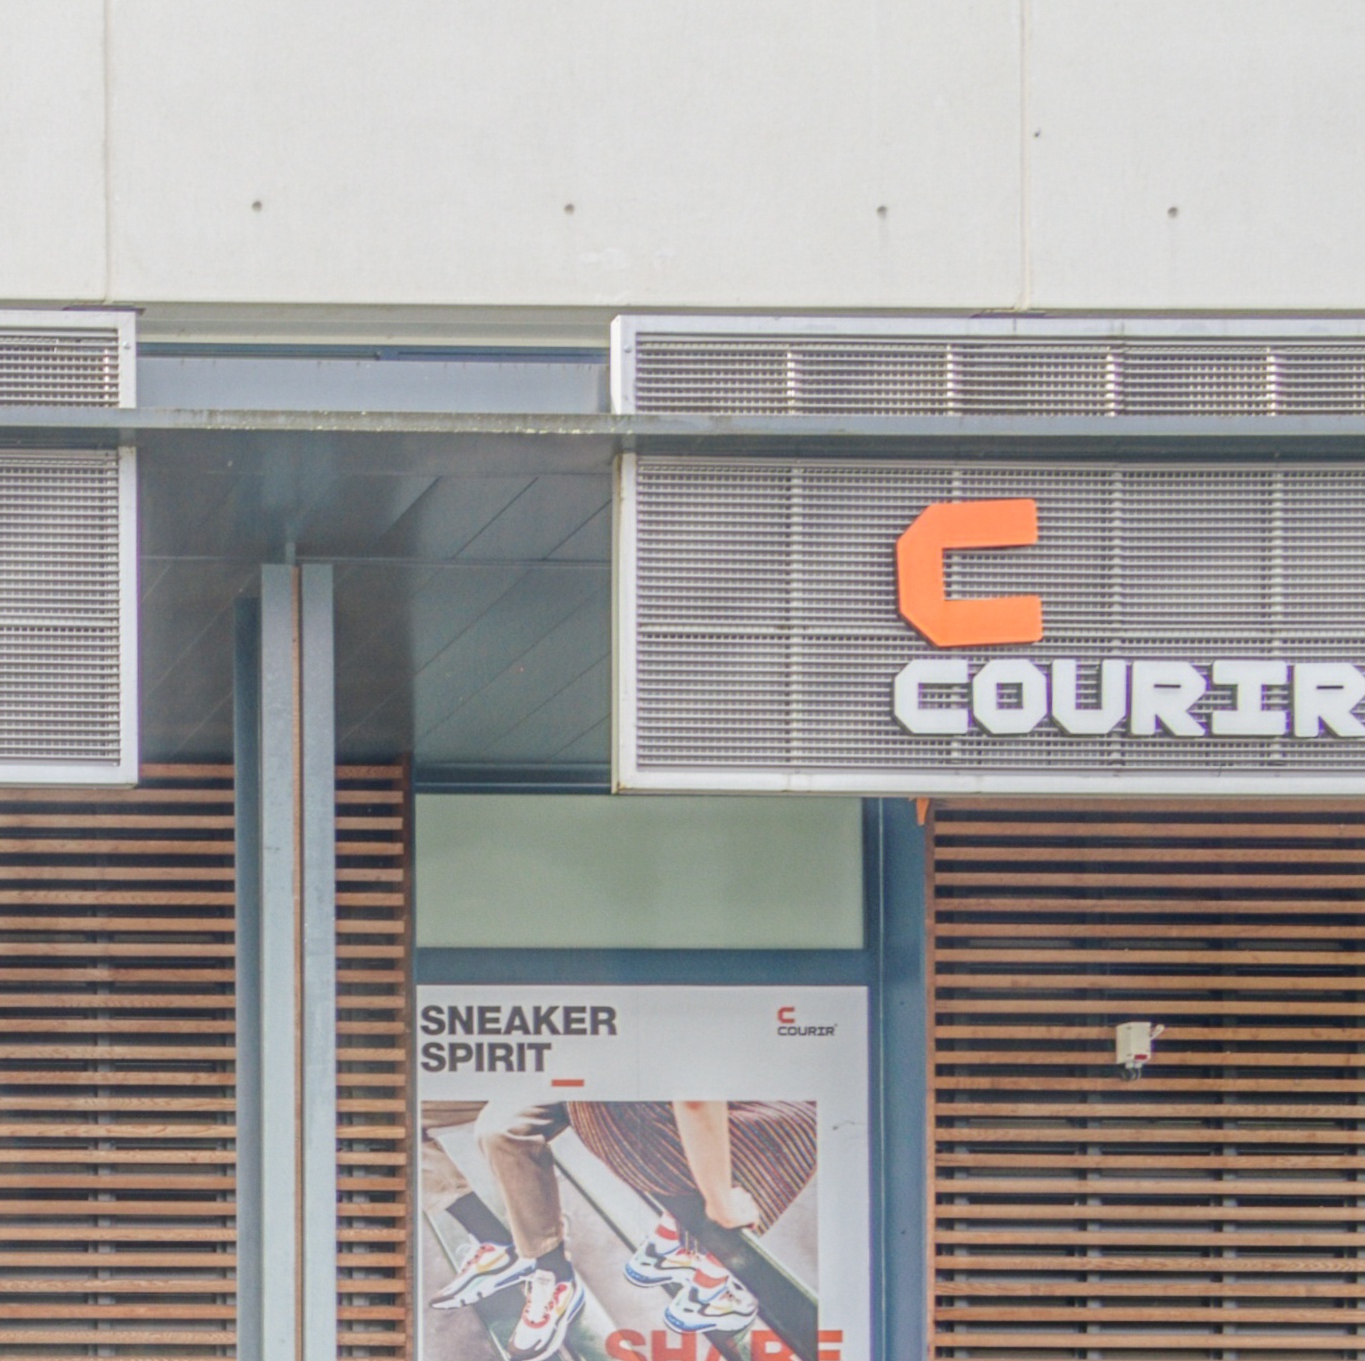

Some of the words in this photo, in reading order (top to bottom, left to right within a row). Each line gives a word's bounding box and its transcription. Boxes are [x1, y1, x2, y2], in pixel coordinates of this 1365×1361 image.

[896, 498, 1043, 647] C
[893, 658, 1365, 738] COURIR
[420, 1005, 617, 1036] SNEAKER
[777, 1026, 835, 1036] COURIR
[420, 1042, 552, 1073] SPIRIT
